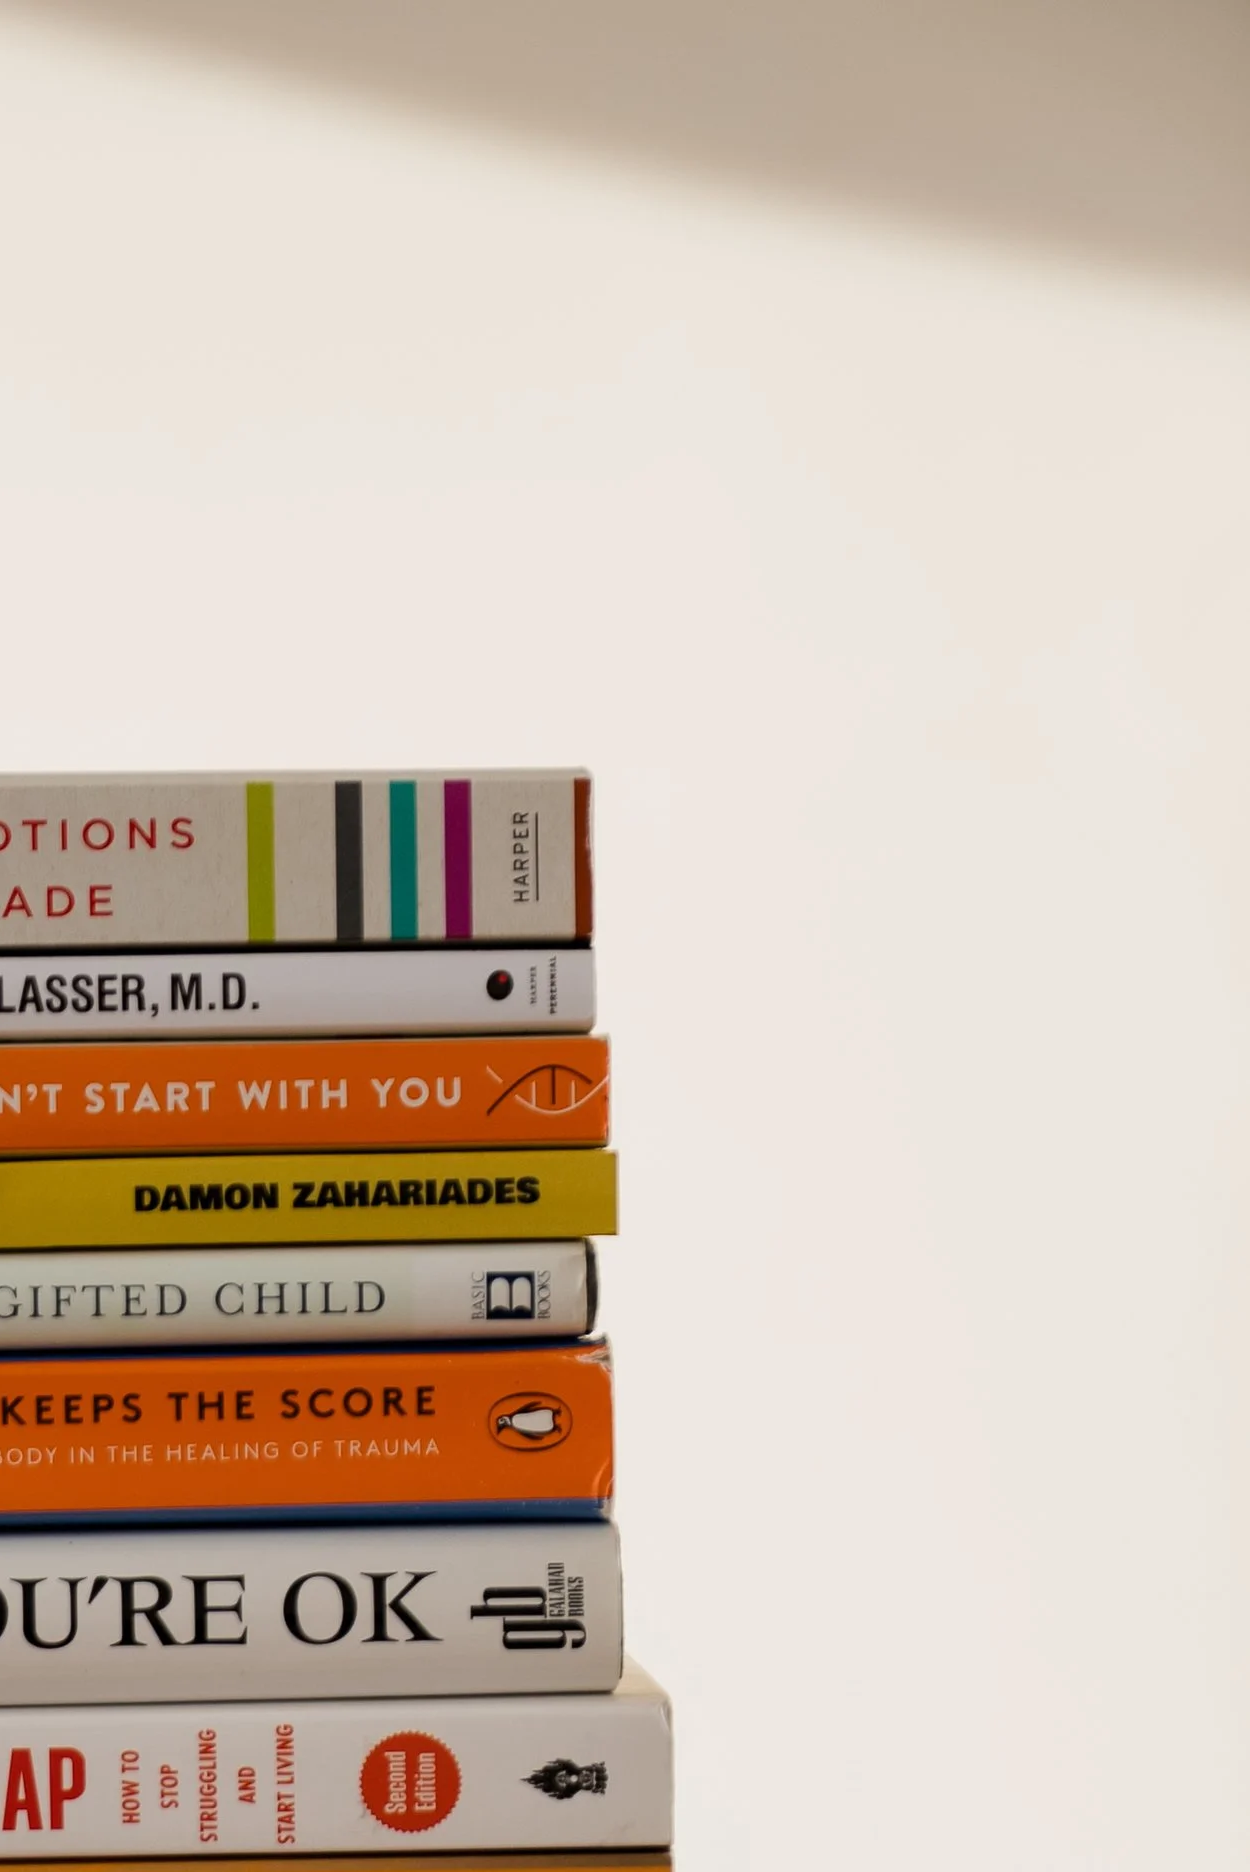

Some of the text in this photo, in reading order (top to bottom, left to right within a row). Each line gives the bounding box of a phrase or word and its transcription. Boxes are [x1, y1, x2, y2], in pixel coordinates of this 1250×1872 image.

[512, 810, 530, 903] HARPER
[169, 972, 260, 1011] M.D.
[84, 1079, 217, 1114] START
[237, 1077, 348, 1112] WITH
[369, 1075, 463, 1109] YOU
[133, 1175, 541, 1212] DAMON ZAHARIADES
[214, 1279, 387, 1316] CHILD
[471, 1271, 485, 1319] BASIC
[537, 1270, 551, 1318] BOOKS
[0, 1393, 143, 1427] KEEPS
[167, 1390, 255, 1423] THE
[280, 1385, 436, 1419] SCORE
[69, 1445, 95, 1464] IN
[107, 1443, 153, 1463] THE
[166, 1440, 280, 1462] HEALING
[291, 1439, 323, 1459] OF
[333, 1437, 439, 1458] TRAUMA
[282, 1571, 444, 1645] OK
[548, 1562, 565, 1616] GALAHAD
[567, 1576, 584, 1616] BOOKS
[122, 1750, 140, 1824] HOW TO
[160, 1764, 179, 1809] STOP
[198, 1728, 218, 1842] STRUGGLING
[238, 1766, 256, 1804] AND
[275, 1723, 295, 1844] START LIVING
[384, 1750, 407, 1814] Second
[415, 1752, 437, 1812] Edition
